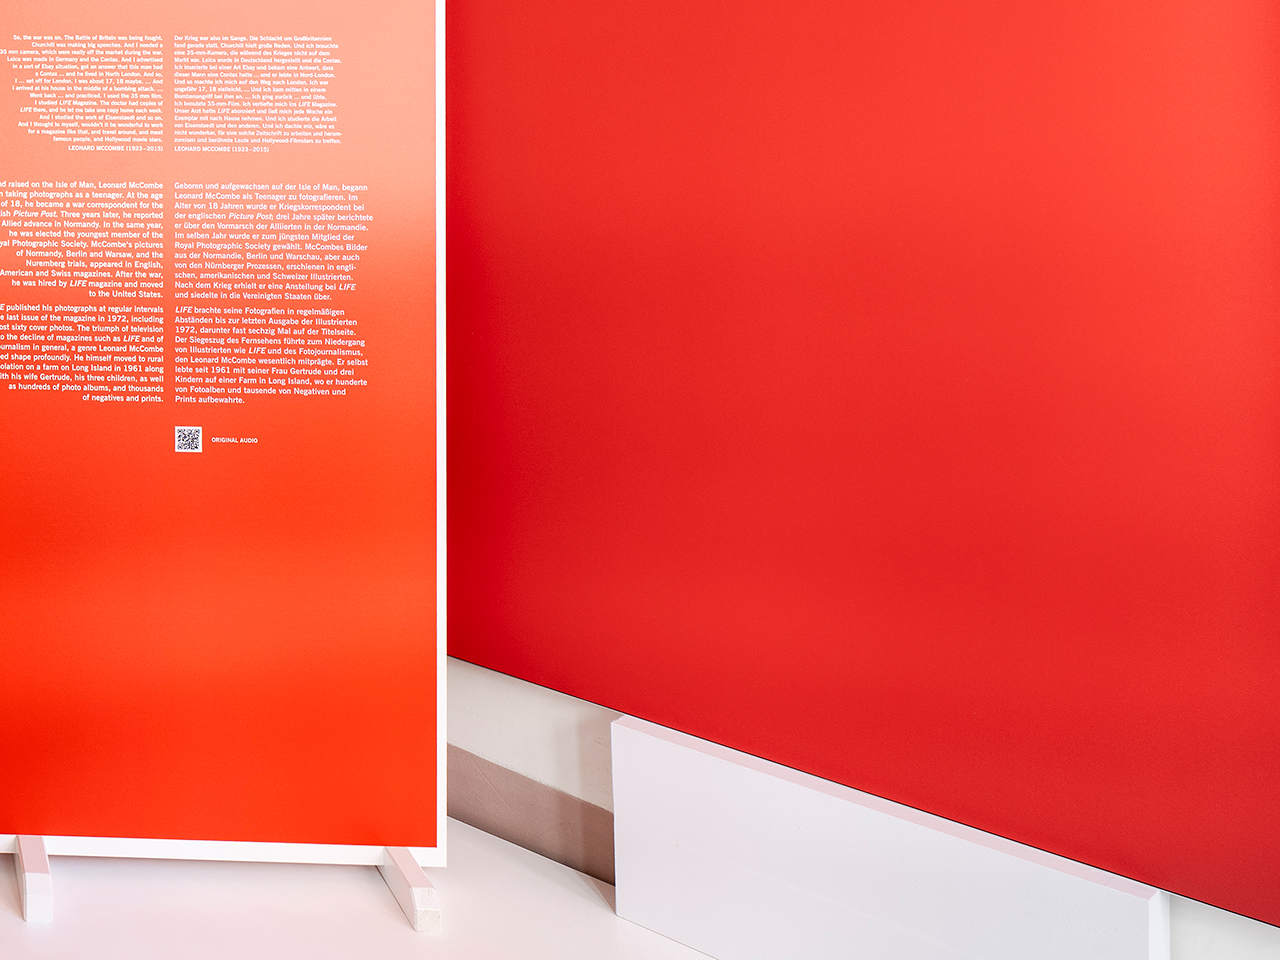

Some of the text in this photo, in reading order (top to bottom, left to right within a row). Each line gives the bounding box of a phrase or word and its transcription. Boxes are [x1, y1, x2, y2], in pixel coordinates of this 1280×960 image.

[8, 179, 30, 188] raised
[41, 180, 54, 188] the
[55, 180, 68, 188] Isle
[69, 180, 77, 188] of
[78, 180, 97, 190] Man,
[98, 180, 127, 189] Leonard
[128, 181, 164, 189] McCombe
[174, 181, 368, 193] Geboren und aufgewachsen auf der Isle of Man, begann
[5, 189, 28, 199] taking
[29, 190, 73, 200] photographs
[91, 190, 124, 200] teenager.
[126, 191, 135, 199] At
[136, 191, 149, 199] the
[150, 193, 163, 201] age
[174, 191, 203, 200] Leonard
[205, 192, 241, 200] McCombe
[242, 192, 253, 200] als
[255, 192, 286, 202] Teenager
[298, 193, 346, 203] fotografieren.
[348, 193, 358, 201] Im
[0, 199, 8, 207] of
[10, 199, 23, 209] 18,
[24, 199, 34, 208] he
[35, 200, 64, 208] became
[86, 200, 138, 210] correspondent
[139, 201, 150, 209] for
[151, 201, 164, 209] the
[174, 201, 191, 209] Alter
[208, 201, 219, 210] 18
[220, 202, 244, 210] Jahren
[246, 202, 268, 210] wurde
[278, 202, 352, 212] Kriegskorrespondent
[353, 203, 365, 211] bei
[13, 209, 39, 218] Picture
[40, 210, 58, 218] Post.
[60, 210, 80, 218] Three
[82, 212, 101, 220] years
[102, 210, 121, 220] later,
[122, 210, 132, 219] he
[133, 211, 164, 221] reported
[6, 303, 41, 313] published
[41, 303, 53, 312] his
[54, 304, 97, 314] photographs
[99, 304, 106, 312] at
[107, 304, 132, 314] regular
[134, 305, 164, 313] intervals
[175, 305, 345, 318] LIFE brachte seine Fotografien in regelmäßigen
[6, 313, 19, 321] last
[20, 313, 39, 321] issue
[40, 313, 48, 321] of
[49, 313, 61, 322] the
[63, 314, 96, 324] magazine
[97, 314, 105, 322] in
[107, 314, 129, 324] 1972,
[130, 315, 164, 325] including
[174, 315, 213, 324] Abständen
[214, 316, 226, 324] bis
[241, 316, 267, 324] letzten
[268, 317, 299, 327] Ausgabe
[301, 317, 313, 325] der
[315, 318, 358, 326] Illustrierten
[11, 322, 27, 332] sixty
[49, 323, 75, 333] photos.
[77, 324, 90, 332] The
[91, 324, 120, 334] triumph
[121, 324, 129, 332] of
[130, 324, 164, 333] television
[175, 325, 356, 336] 1972, darunter fast sechzig Mal auf der Titelseite.
